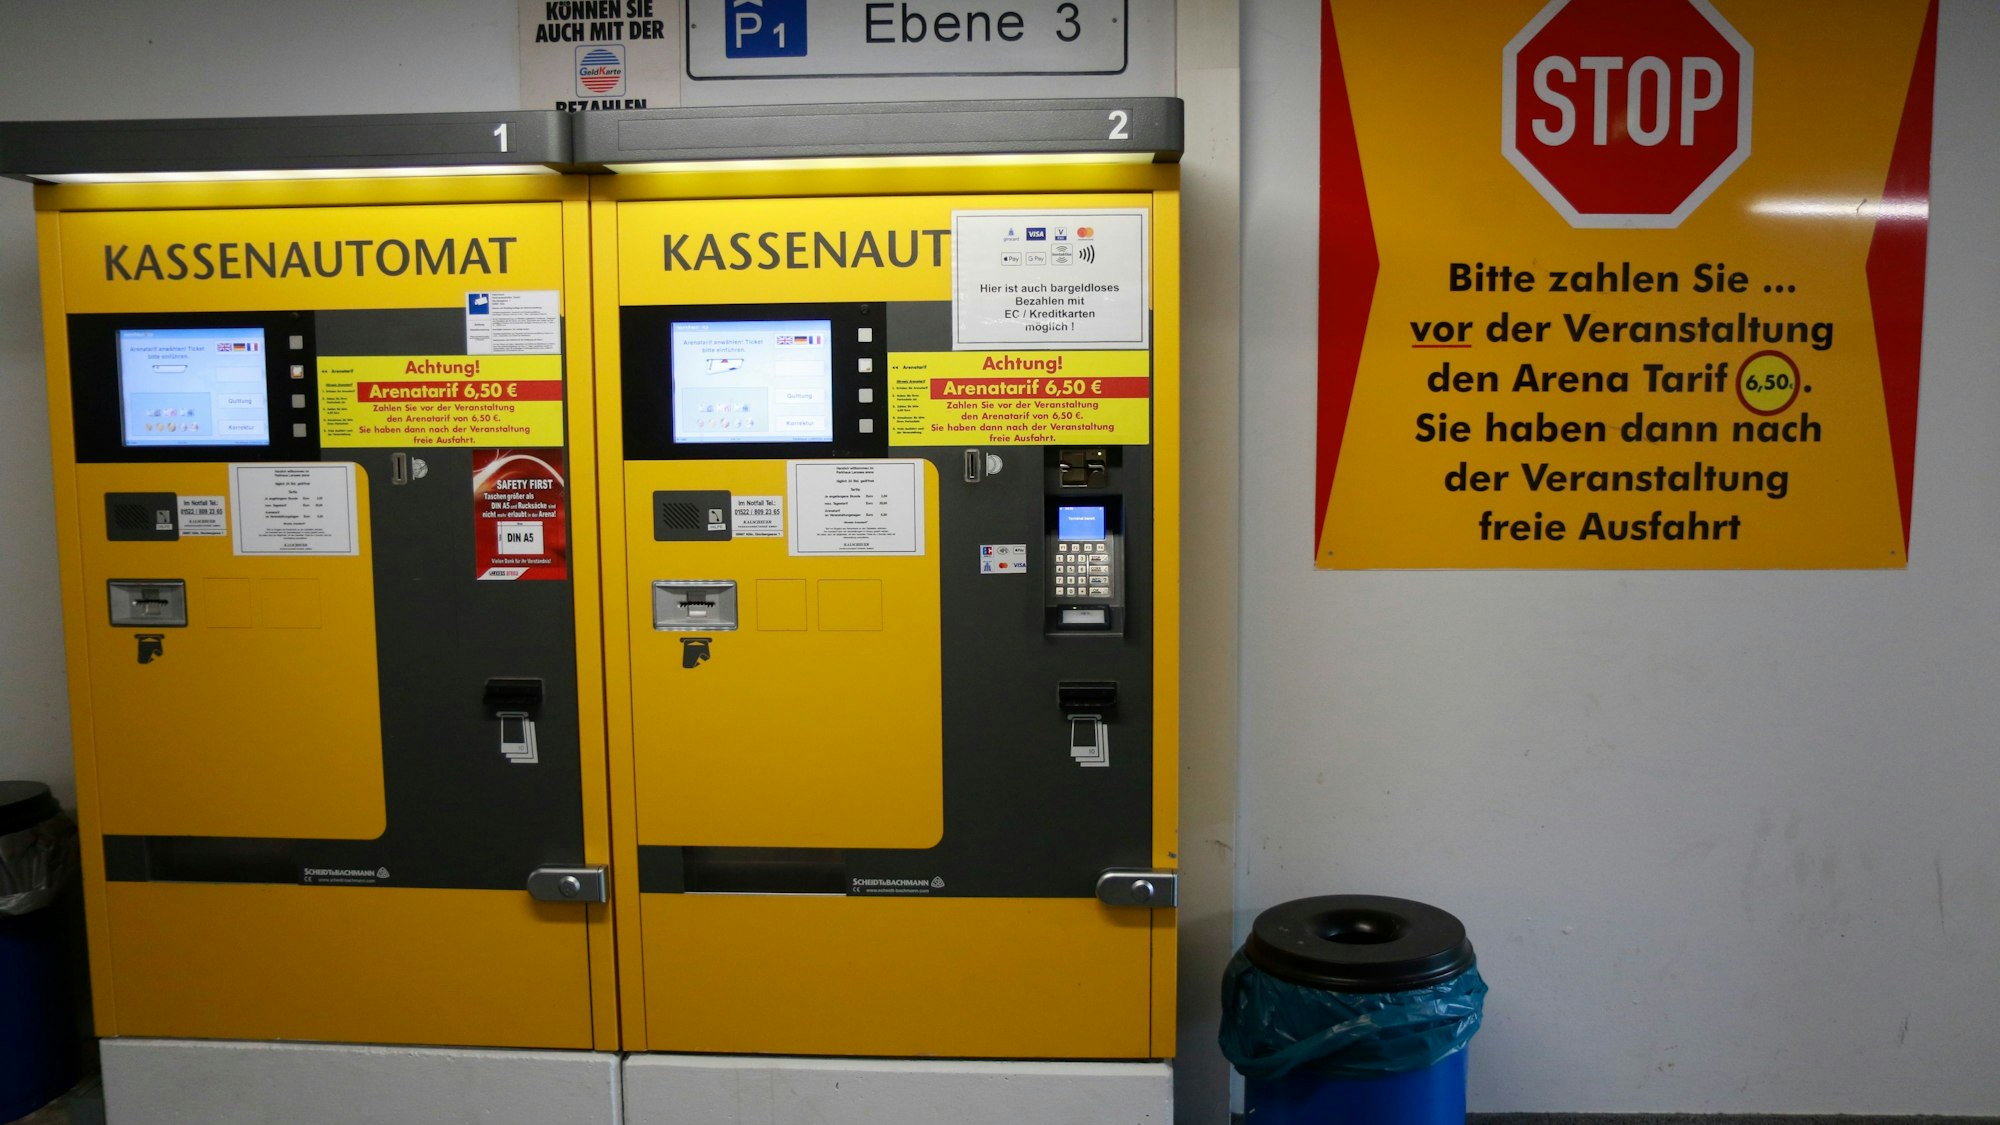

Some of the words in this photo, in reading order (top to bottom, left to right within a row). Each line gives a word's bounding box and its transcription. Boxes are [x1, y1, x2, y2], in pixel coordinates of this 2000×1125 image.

[547, 0, 621, 20] KÖNNEN
[627, 0, 653, 18] SIE
[536, 23, 584, 42] AUCH
[590, 22, 624, 41] MIT
[630, 20, 664, 40] DER
[865, 3, 1024, 43] Ebene
[1056, 3, 1081, 42] 3
[579, 66, 622, 76] GeldKarte
[1532, 56, 1723, 146] STOP
[1108, 110, 1128, 140] 2
[494, 124, 508, 152] 1
[104, 237, 518, 282] KASSENAUTOMAT
[1450, 262, 1535, 292] Bitte
[1549, 262, 1678, 293] zahlen
[1693, 262, 1748, 293] Sie
[1764, 284, 1796, 293] ...
[980, 284, 1002, 292] Hier
[1005, 284, 1018, 292] ist
[1021, 284, 1047, 292] auch
[1050, 283, 1119, 294] bargeldloses
[1016, 296, 1064, 306] Bezahlen
[1068, 297, 1084, 306] mit
[1005, 310, 1019, 318] EC
[1023, 310, 1026, 318] /
[1030, 309, 1095, 318] Kreditkarten
[1025, 322, 1067, 333] möglich
[1072, 322, 1074, 331] !
[1410, 321, 1473, 343] vor
[1486, 312, 1551, 342] der
[1563, 312, 1833, 350] Veranstaltung
[405, 359, 480, 378] Achtung!
[982, 355, 1062, 374] Achtung!
[1428, 362, 1498, 392] den
[1512, 364, 1628, 392] Arena
[1643, 362, 1728, 392] Tarif
[369, 382, 458, 398] Arenatarif
[464, 383, 502, 400] 6,50
[507, 383, 517, 397] €
[943, 379, 1039, 395] Arenatarif
[1045, 379, 1086, 396] 6,50
[1091, 379, 1102, 394] €
[454, 403, 514, 412] Veranstaltung
[1034, 400, 1098, 410] Veranstaltung
[406, 414, 450, 422] Arenatarif
[961, 412, 978, 420] den
[982, 412, 1029, 420] Arenatarif
[1052, 412, 1072, 420] 6,50
[470, 425, 530, 434] Veranstaltung
[1050, 422, 1114, 432] Veranstaltung
[1416, 412, 1471, 442] Sie
[1486, 412, 1606, 442] haben
[1621, 412, 1717, 442] dann
[1732, 411, 1822, 442] nach
[436, 436, 475, 444] Ausfahrt.
[1014, 434, 1056, 442] Ausfahrt.
[497, 480, 527, 489] SAFETY
[530, 480, 553, 489] FIRST
[1445, 462, 1509, 492] der
[1521, 462, 1788, 500] Veranstaltung
[1479, 510, 1566, 540] freie
[1578, 510, 1741, 540] Ausfahrt
[507, 533, 521, 542] DIN
[524, 533, 534, 542] A5
